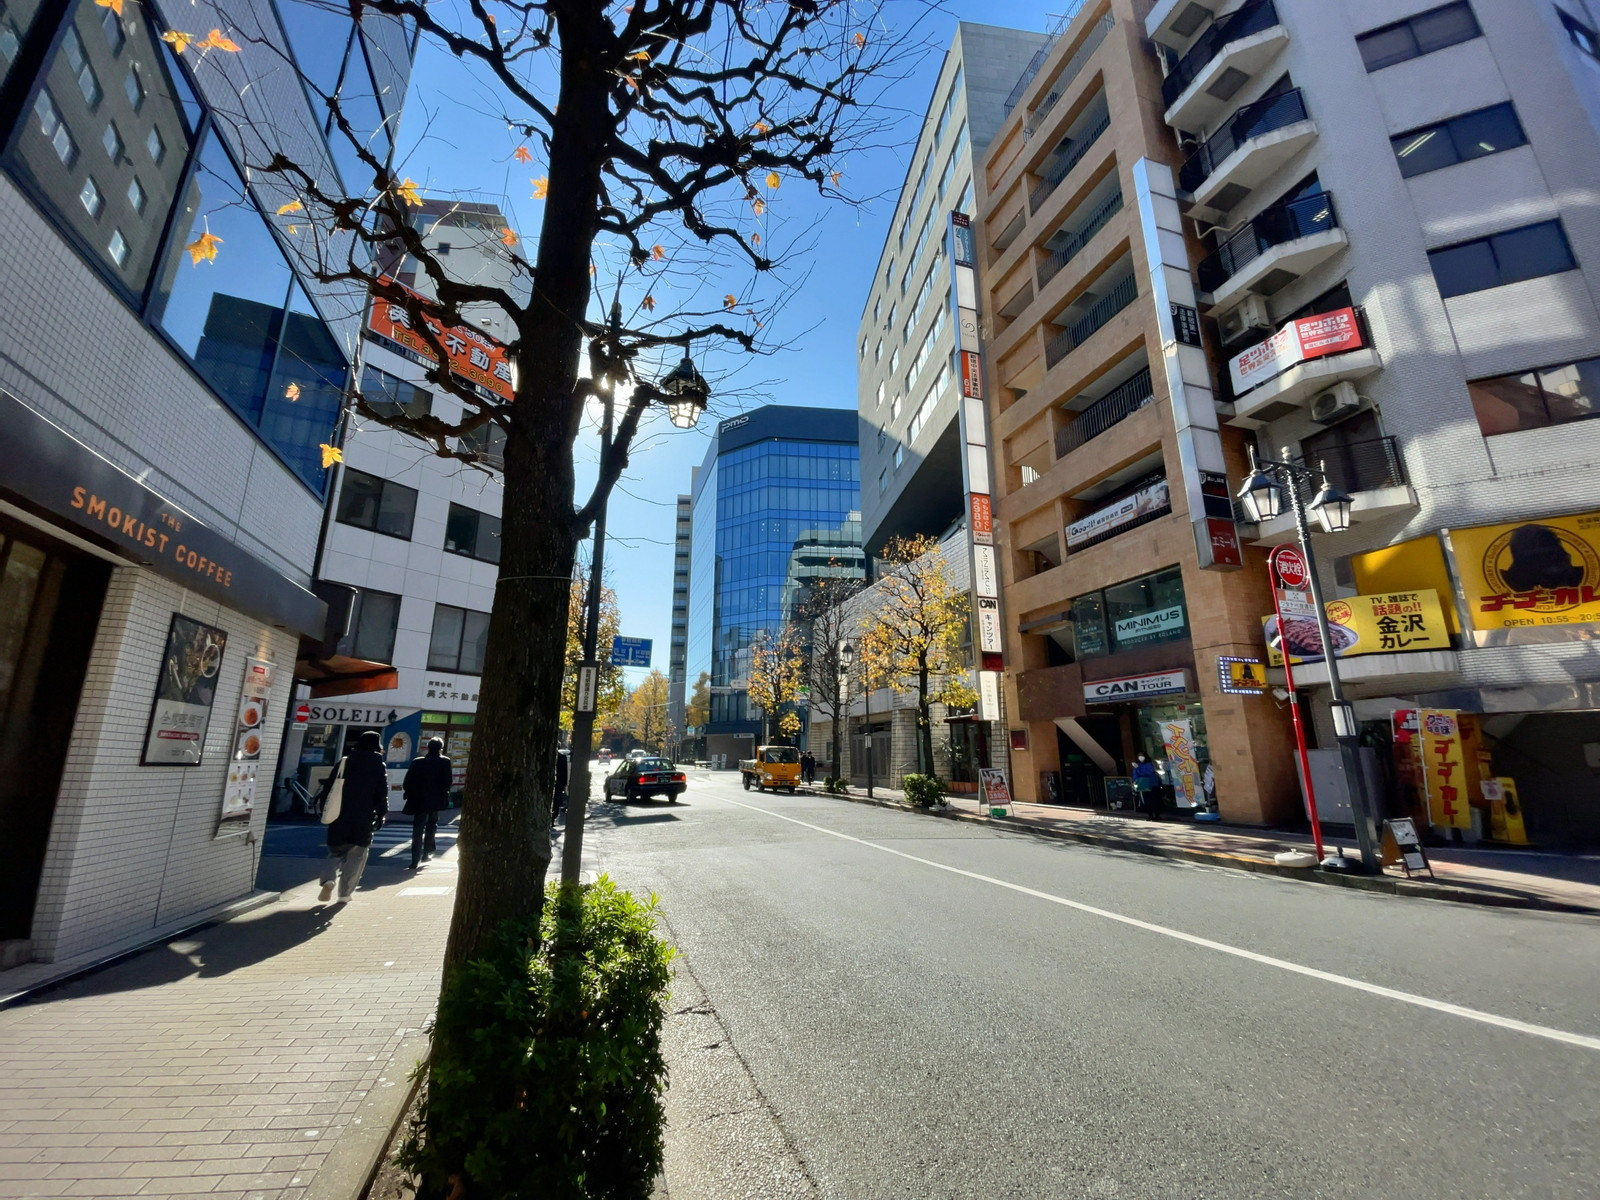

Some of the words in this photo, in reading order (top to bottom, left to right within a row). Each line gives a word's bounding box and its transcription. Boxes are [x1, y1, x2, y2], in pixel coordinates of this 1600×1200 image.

[393, 329, 419, 350] TEL
[161, 512, 182, 532] THE
[70, 486, 169, 553] SMOKIST
[175, 545, 233, 587] COFFEE
[982, 547, 992, 595] MINIMUS
[1279, 560, 1303, 576] 消火栓
[979, 599, 997, 610] CAN
[1370, 593, 1419, 605] TV、雑誌で
[1480, 585, 1600, 613] ゴーゴーカレ
[1372, 602, 1422, 617] 話題の!!
[1118, 610, 1180, 632] MINIMUS
[1376, 613, 1427, 635] 金沢
[1503, 617, 1535, 627] OPEN
[1379, 634, 1430, 649] カレー
[1095, 681, 1138, 696] CAN
[1140, 681, 1172, 690] TOUR
[310, 706, 386, 724] SOLEIL
[1433, 738, 1459, 825] ゴーゴーカレー
